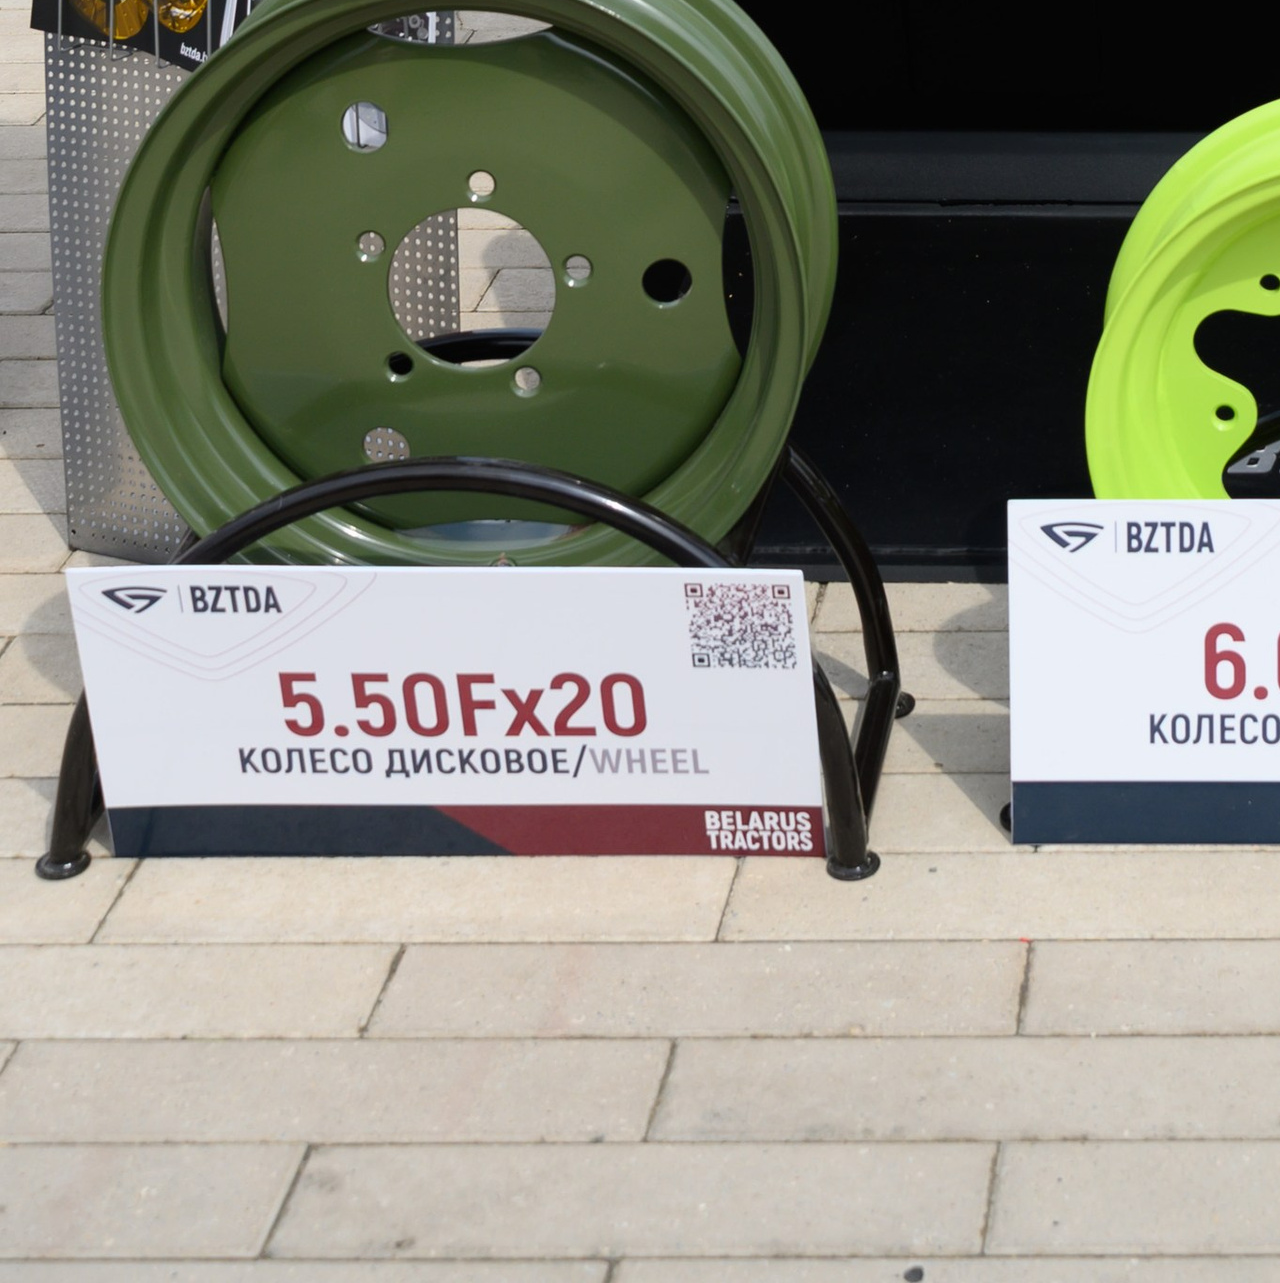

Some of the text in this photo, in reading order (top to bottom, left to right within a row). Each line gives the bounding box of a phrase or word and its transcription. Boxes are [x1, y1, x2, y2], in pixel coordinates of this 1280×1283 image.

[1125, 521, 1215, 554] BZTDA
[189, 585, 282, 615] BZTDA
[278, 671, 648, 738] 5.50Fx20
[238, 743, 710, 778] КОЛЕСО ДИСКОВОЕ/WHEEL
[704, 810, 812, 831] BELARUS
[706, 830, 813, 851] TRACTORS
